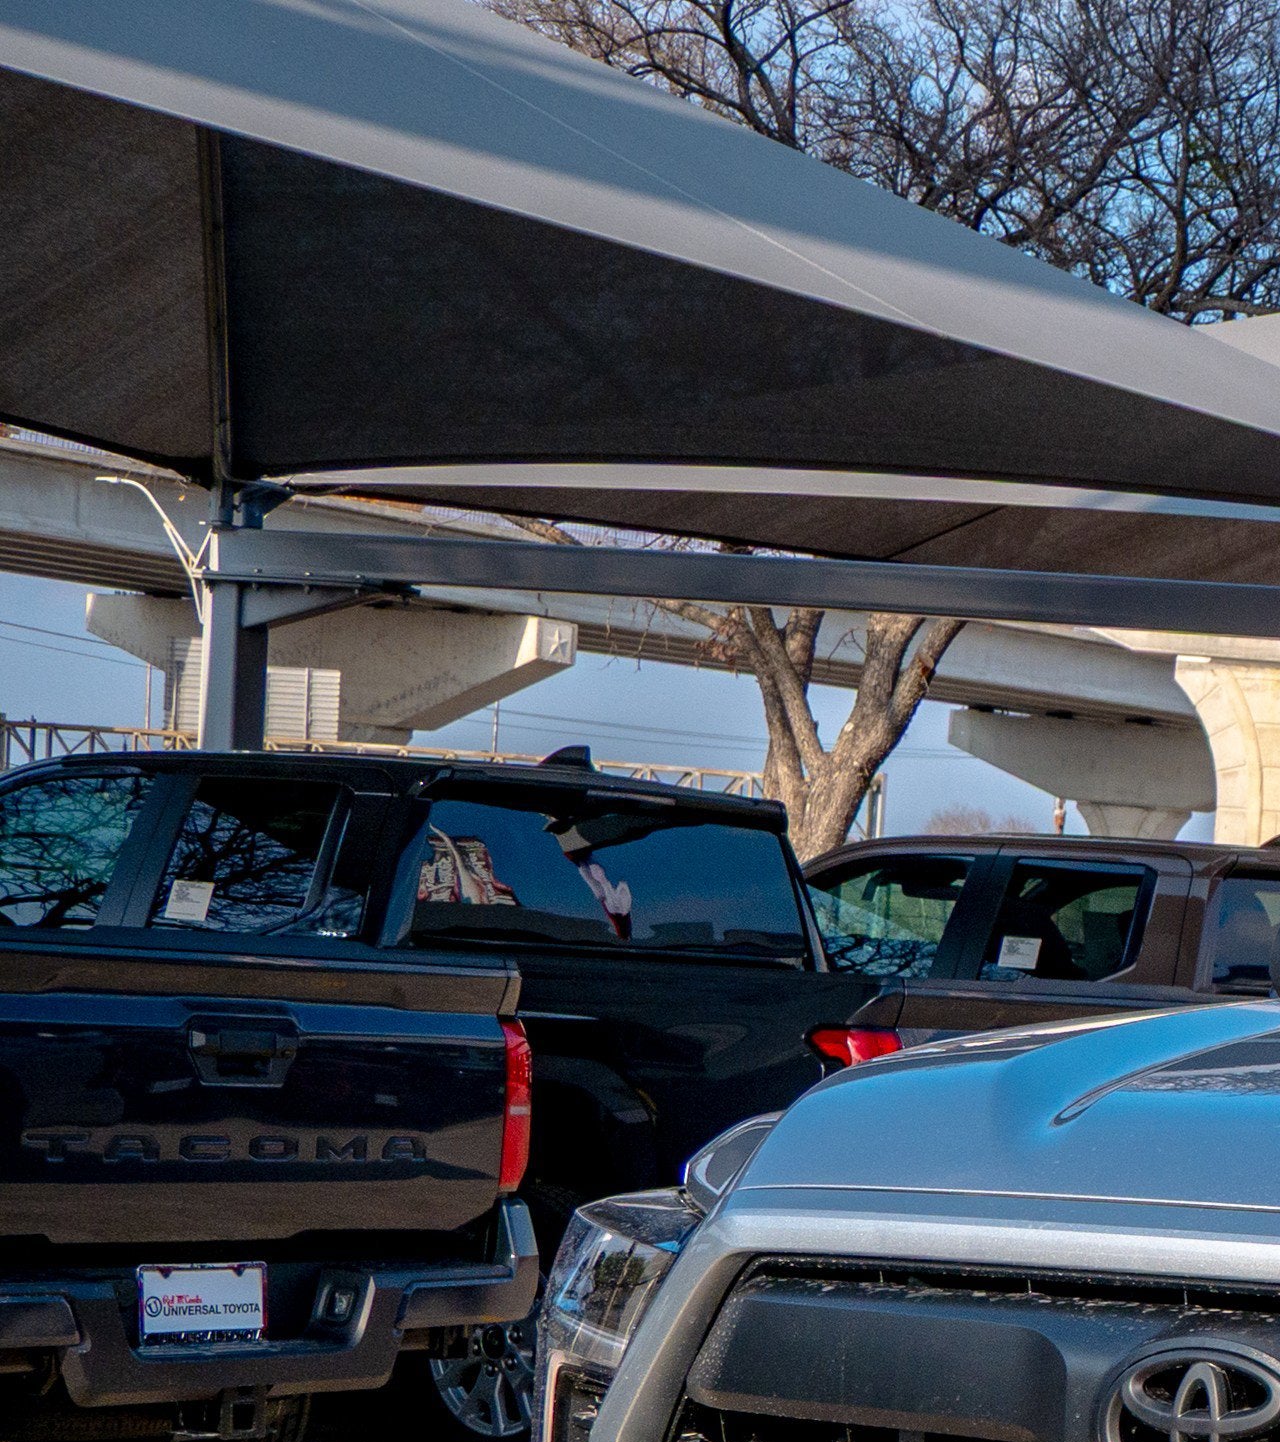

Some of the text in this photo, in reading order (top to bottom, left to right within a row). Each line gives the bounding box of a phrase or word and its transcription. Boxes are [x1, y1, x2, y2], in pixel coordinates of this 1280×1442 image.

[21, 1131, 428, 1164] TACOMA
[163, 1303, 261, 1317] UNIVERSAL TOYOTA
